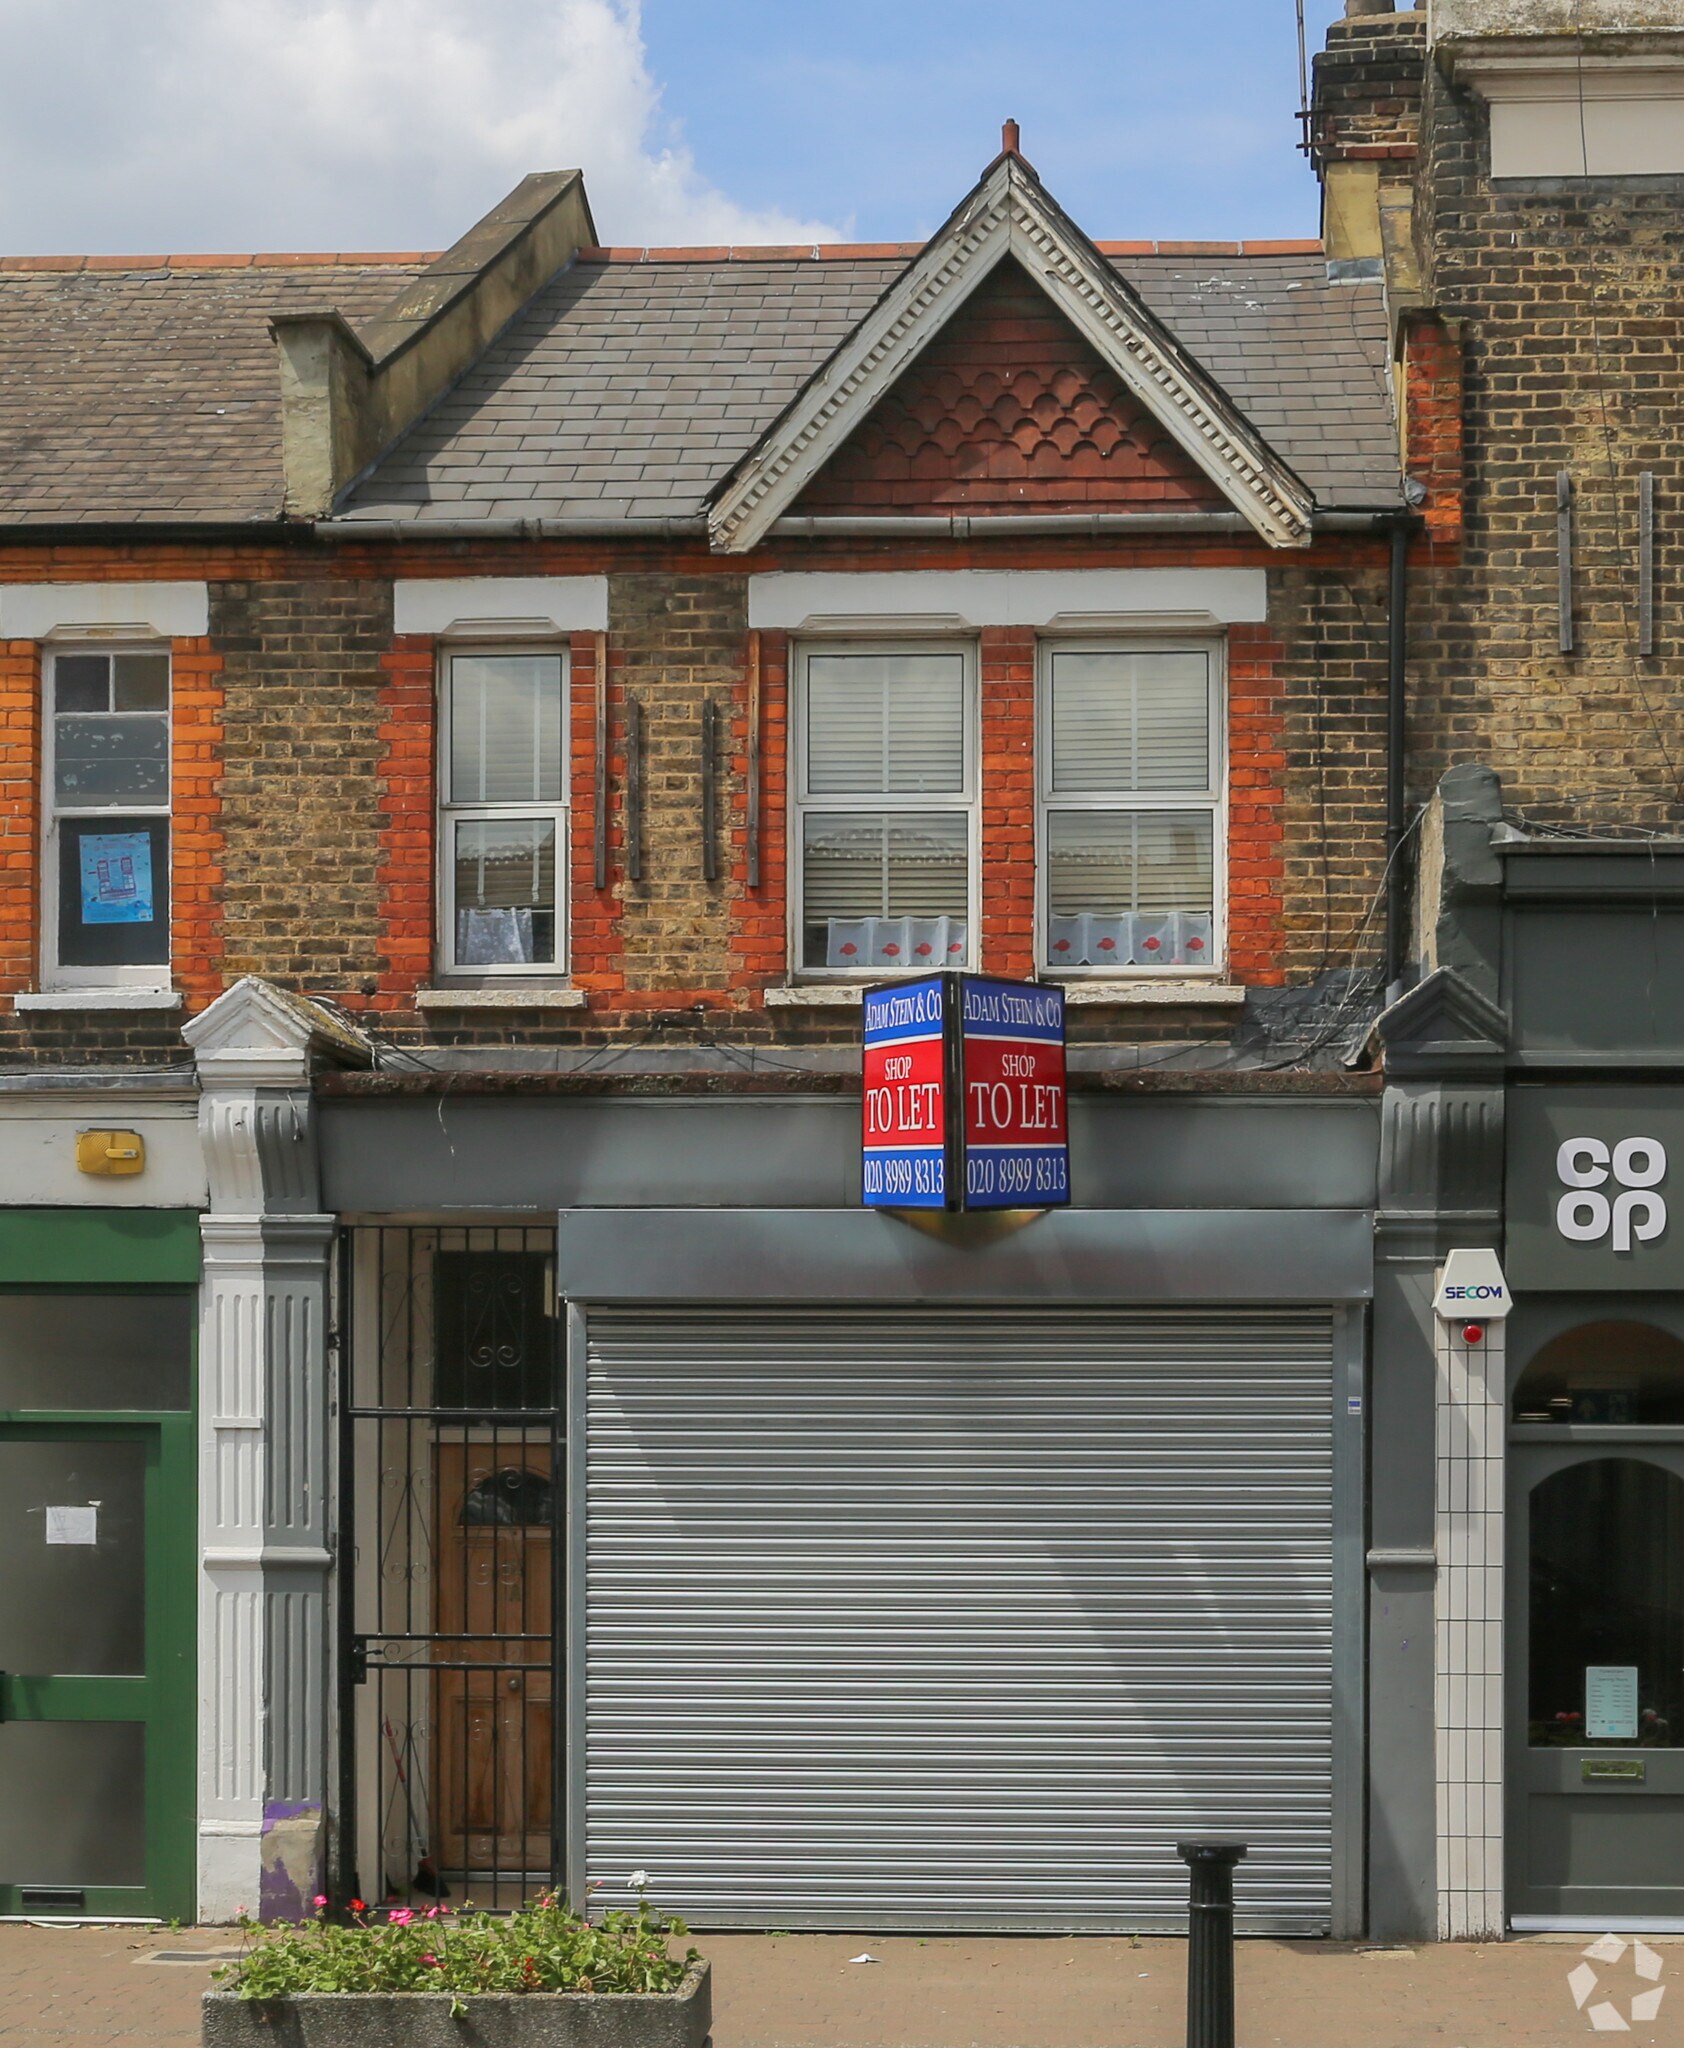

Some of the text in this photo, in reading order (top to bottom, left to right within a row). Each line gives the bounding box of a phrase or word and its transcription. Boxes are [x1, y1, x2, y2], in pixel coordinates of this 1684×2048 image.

[916, 991, 926, 1023] &
[1036, 997, 1045, 1027] &
[885, 1056, 912, 1080] SHOP
[1002, 1054, 1036, 1077] SHOP
[867, 1083, 939, 1132] TO LET
[970, 1083, 1061, 1129] TO LET
[864, 1158, 944, 1194] 020 8989 8313
[967, 1157, 1066, 1194] 020 8989 8313
[1445, 1286, 1502, 1299] SECOM
